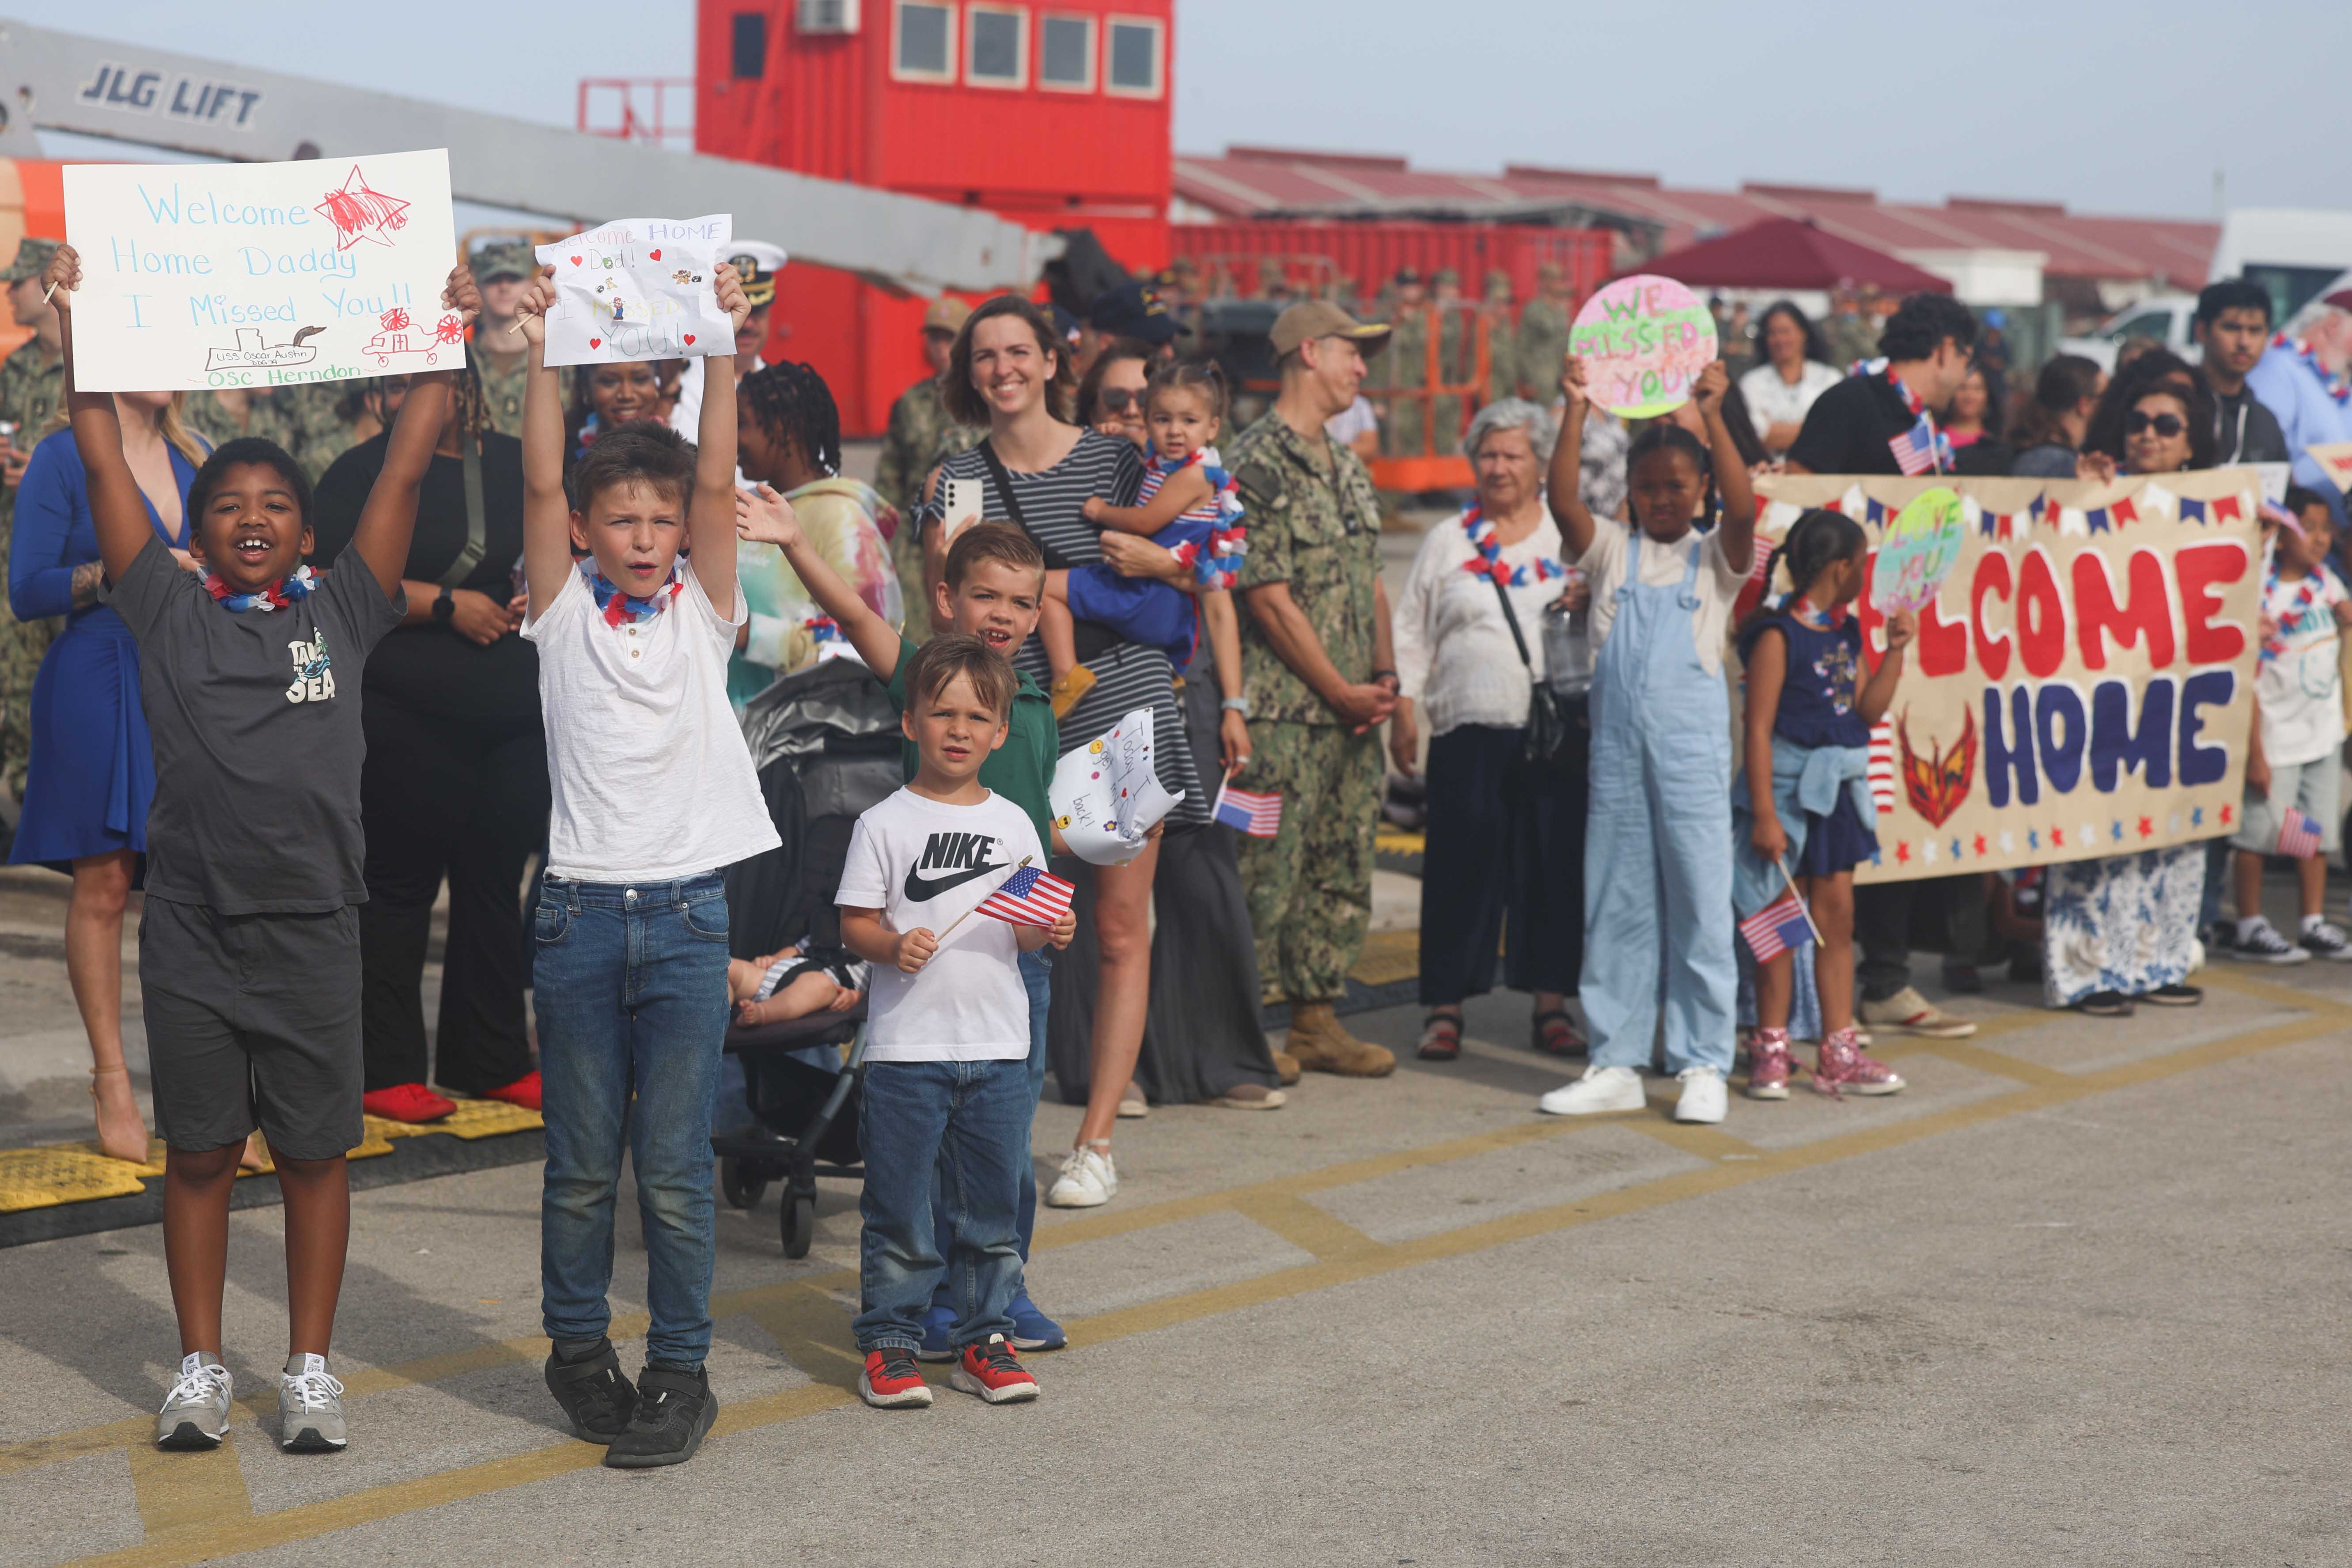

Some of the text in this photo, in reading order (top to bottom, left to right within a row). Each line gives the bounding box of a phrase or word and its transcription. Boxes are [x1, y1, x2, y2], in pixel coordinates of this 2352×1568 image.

[83, 67, 260, 124] JLG LIFT
[138, 183, 310, 225] Welcome
[649, 223, 722, 241] HOME
[111, 237, 356, 283] Home Daddy
[588, 247, 635, 270] Dd!
[123, 295, 152, 328] I
[189, 294, 295, 326] Missed
[593, 299, 681, 318] MSSED
[1602, 284, 1666, 323] WE
[244, 352, 270, 360] Oscar
[599, 322, 683, 357] YOU!
[1576, 322, 1697, 361] MISSED
[208, 364, 360, 386] OSC Herndon
[286, 668, 336, 703] SEA
[1118, 721, 1144, 782] Today
[1984, 669, 2235, 808] HOME
[919, 832, 995, 870] NIKE
